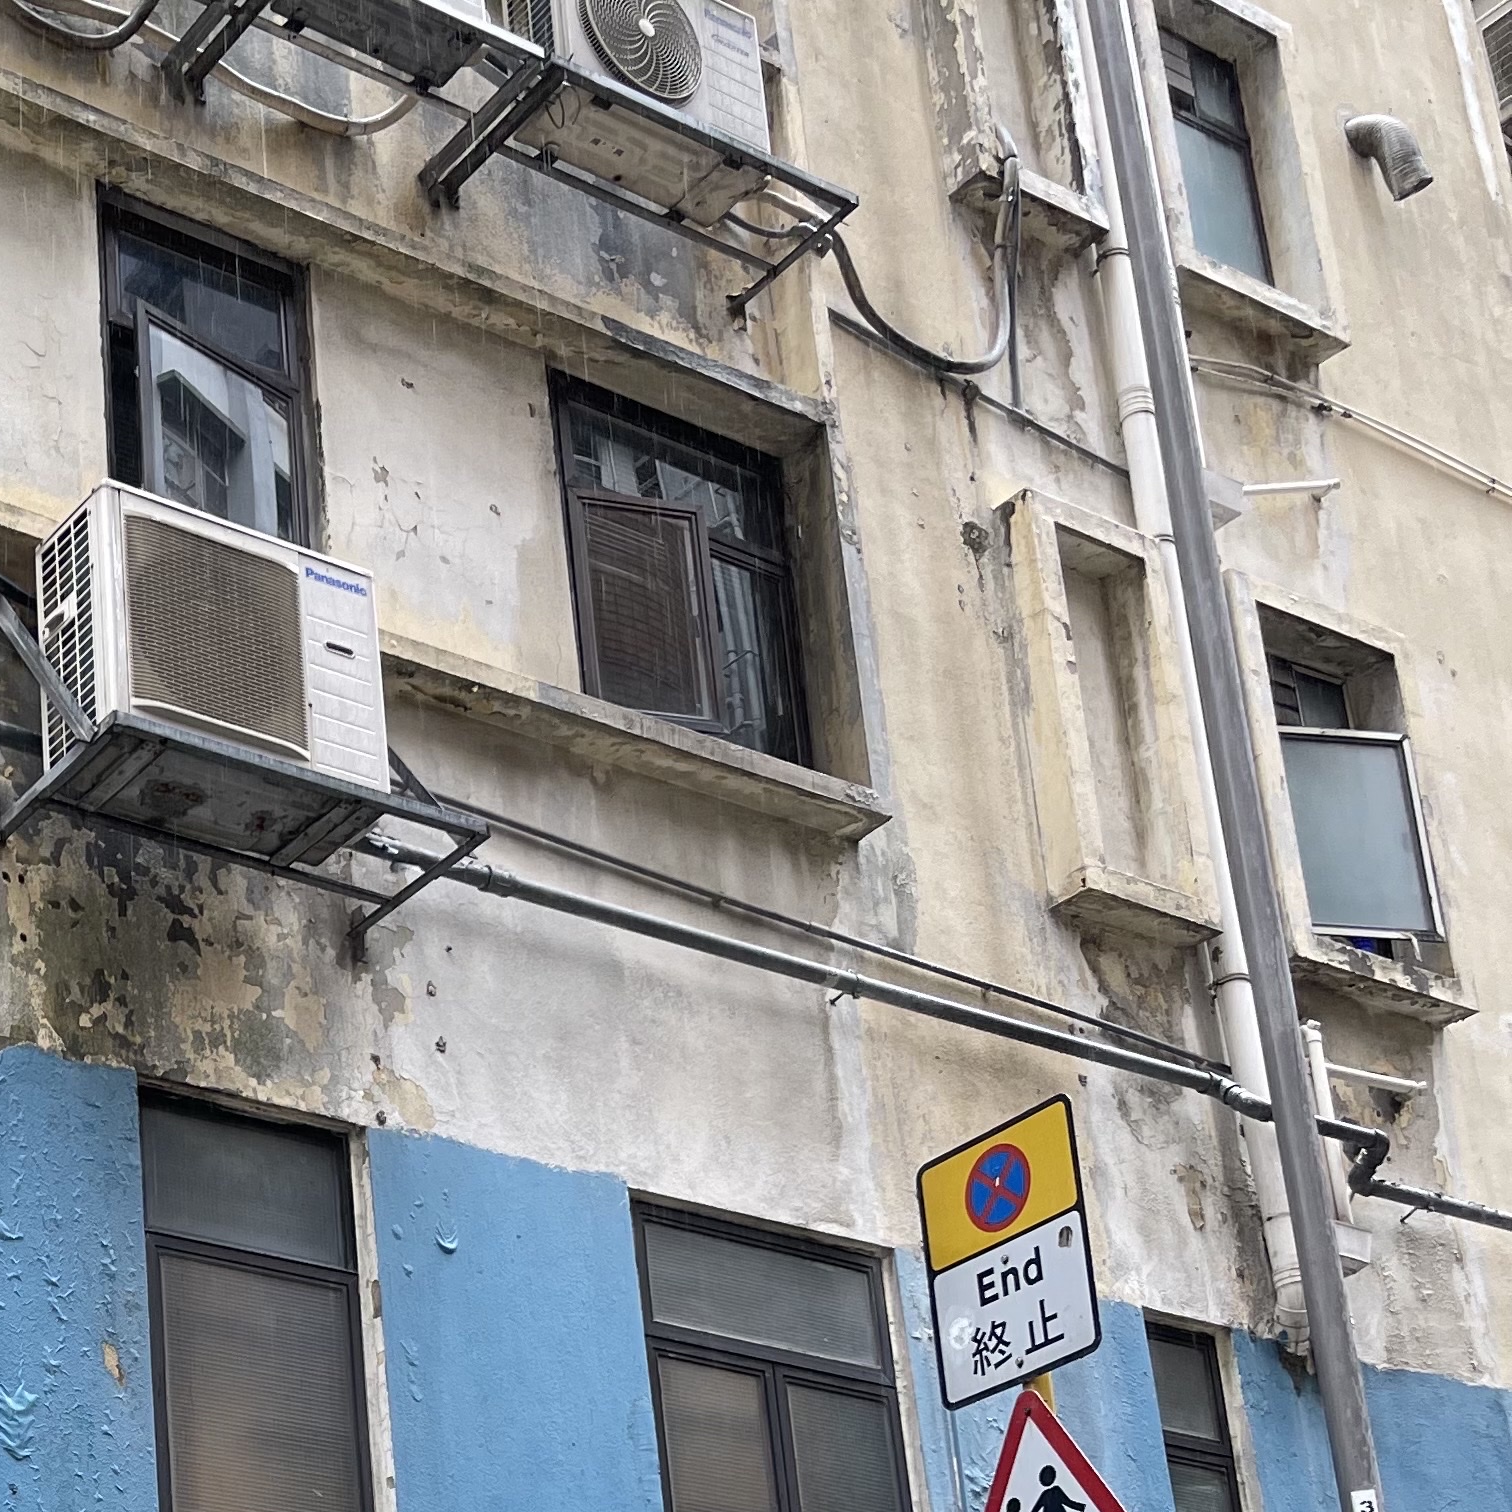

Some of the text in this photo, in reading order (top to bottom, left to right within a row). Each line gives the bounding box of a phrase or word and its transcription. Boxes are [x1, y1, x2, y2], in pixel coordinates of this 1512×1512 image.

[305, 567, 368, 597] Panasonic
[976, 1245, 1044, 1307] End
[971, 1299, 1065, 1377] 終止
